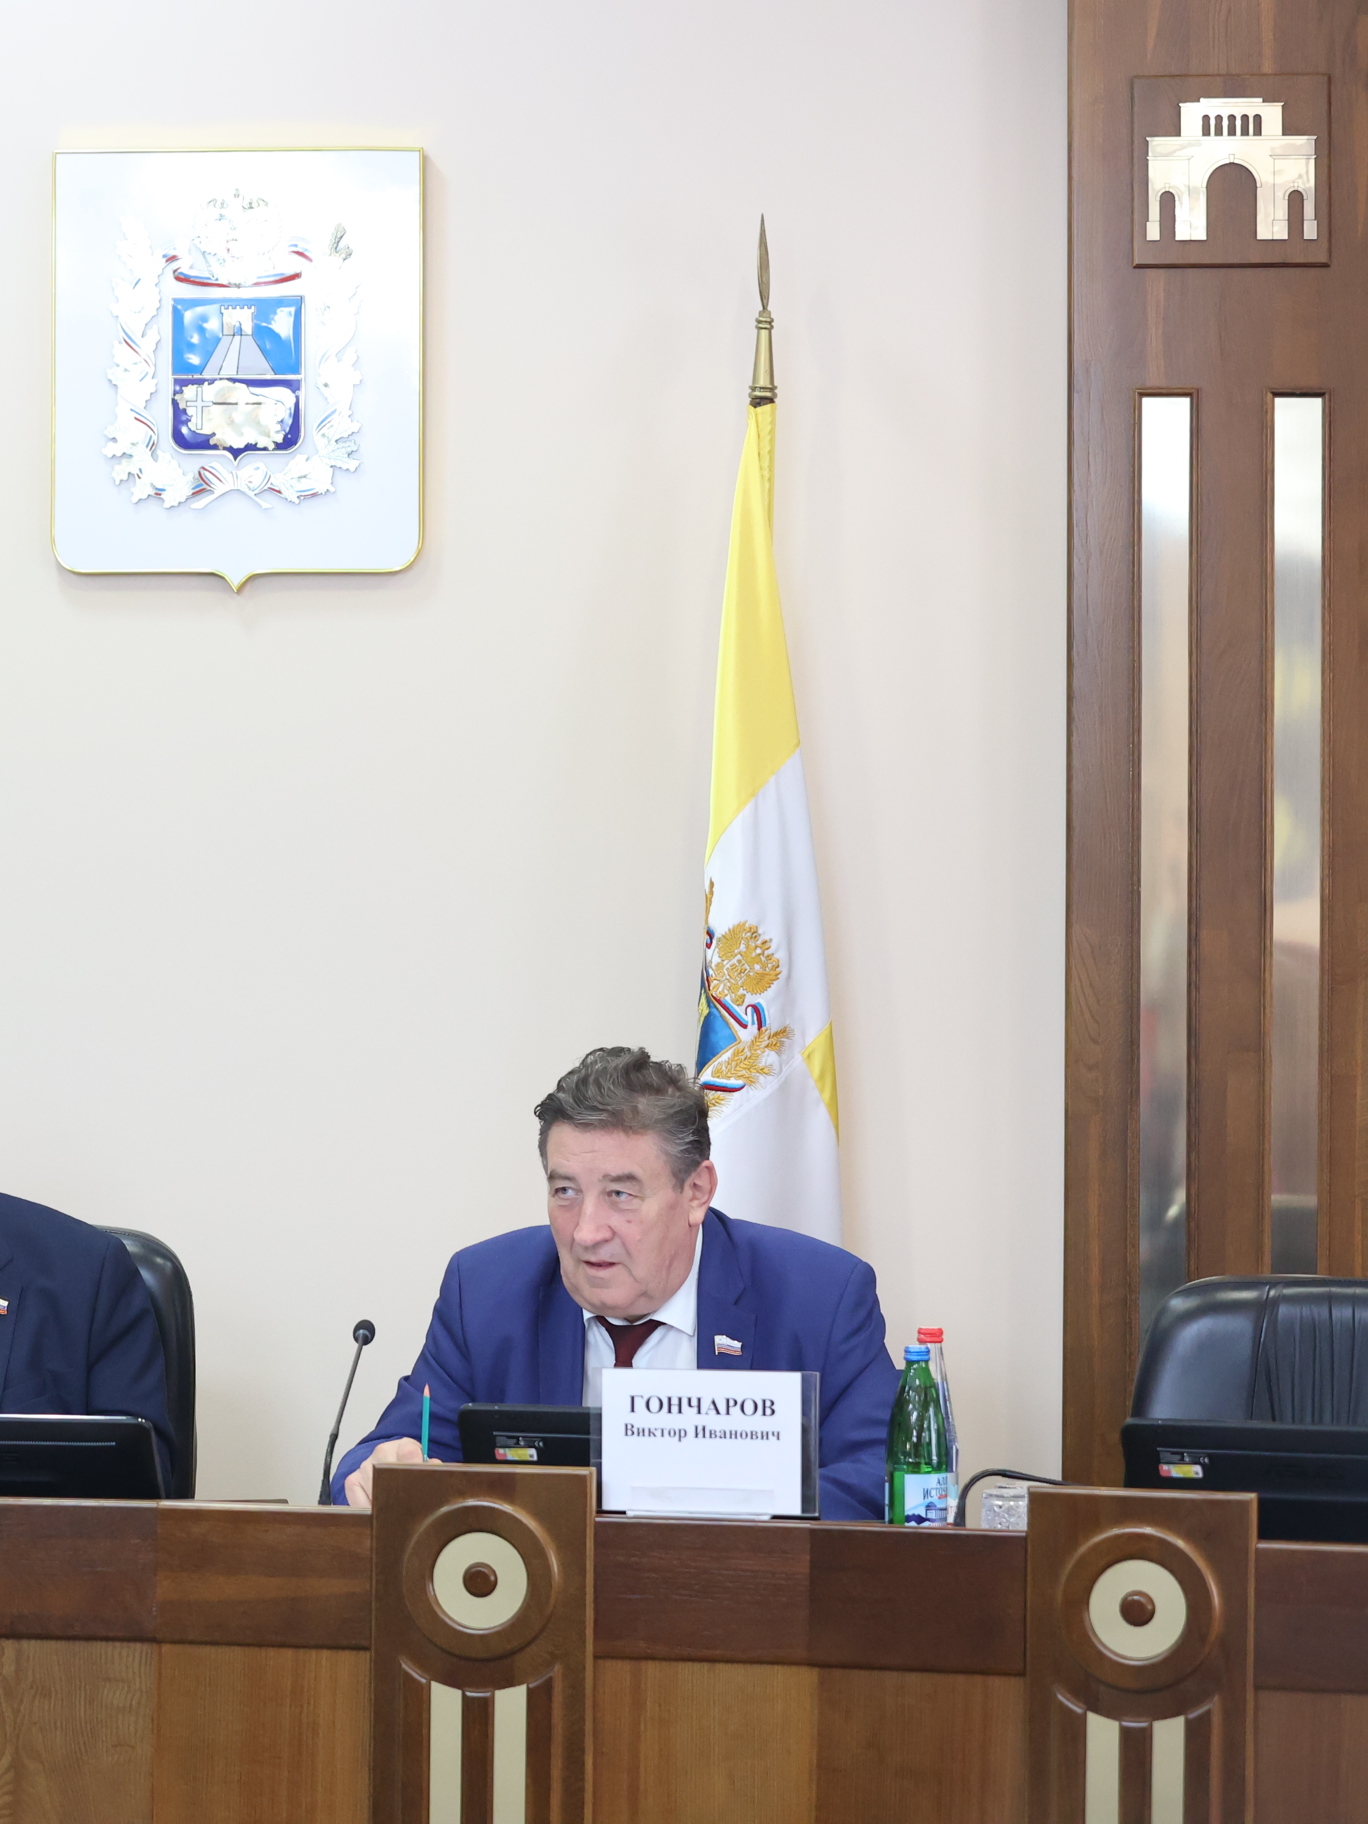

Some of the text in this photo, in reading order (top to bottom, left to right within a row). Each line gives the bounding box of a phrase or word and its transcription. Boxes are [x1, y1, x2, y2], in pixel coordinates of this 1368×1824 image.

[629, 1394, 777, 1417] ГОНЧАРОВ
[624, 1422, 781, 1442] Виктор Иванович
